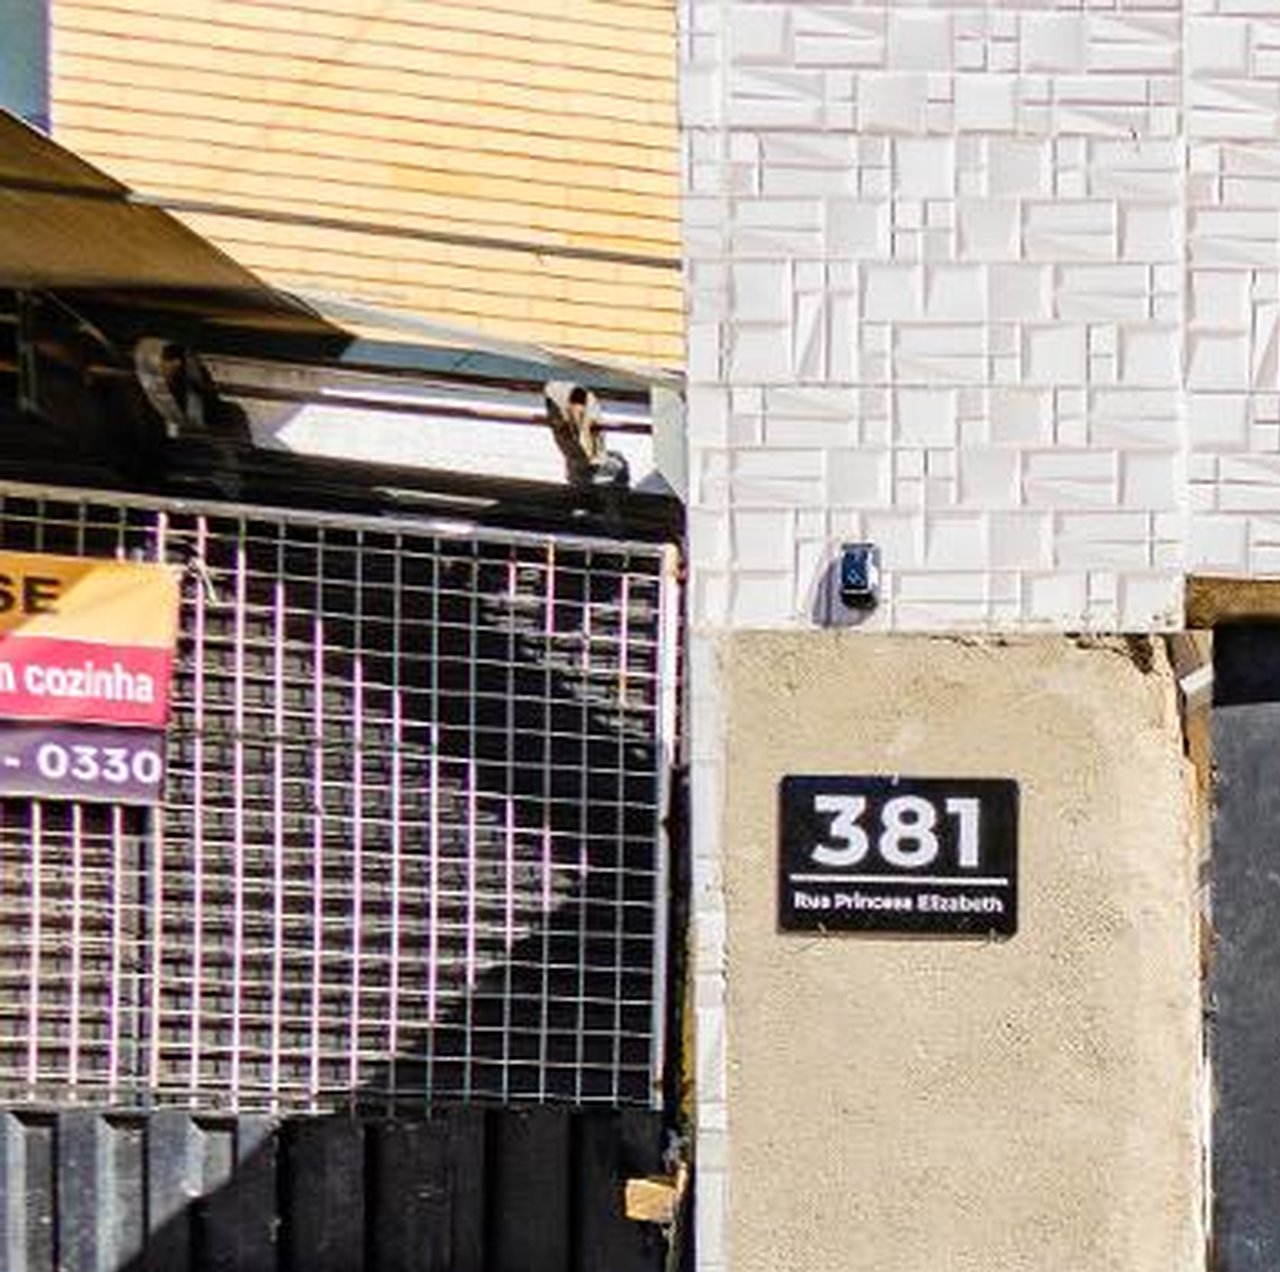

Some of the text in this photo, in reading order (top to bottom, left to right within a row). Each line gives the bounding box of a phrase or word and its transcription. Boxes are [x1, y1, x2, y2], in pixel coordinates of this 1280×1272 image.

[24, 661, 154, 704] cozinha
[36, 744, 162, 784] 0330
[811, 795, 980, 868] 381
[794, 891, 830, 910] Rua
